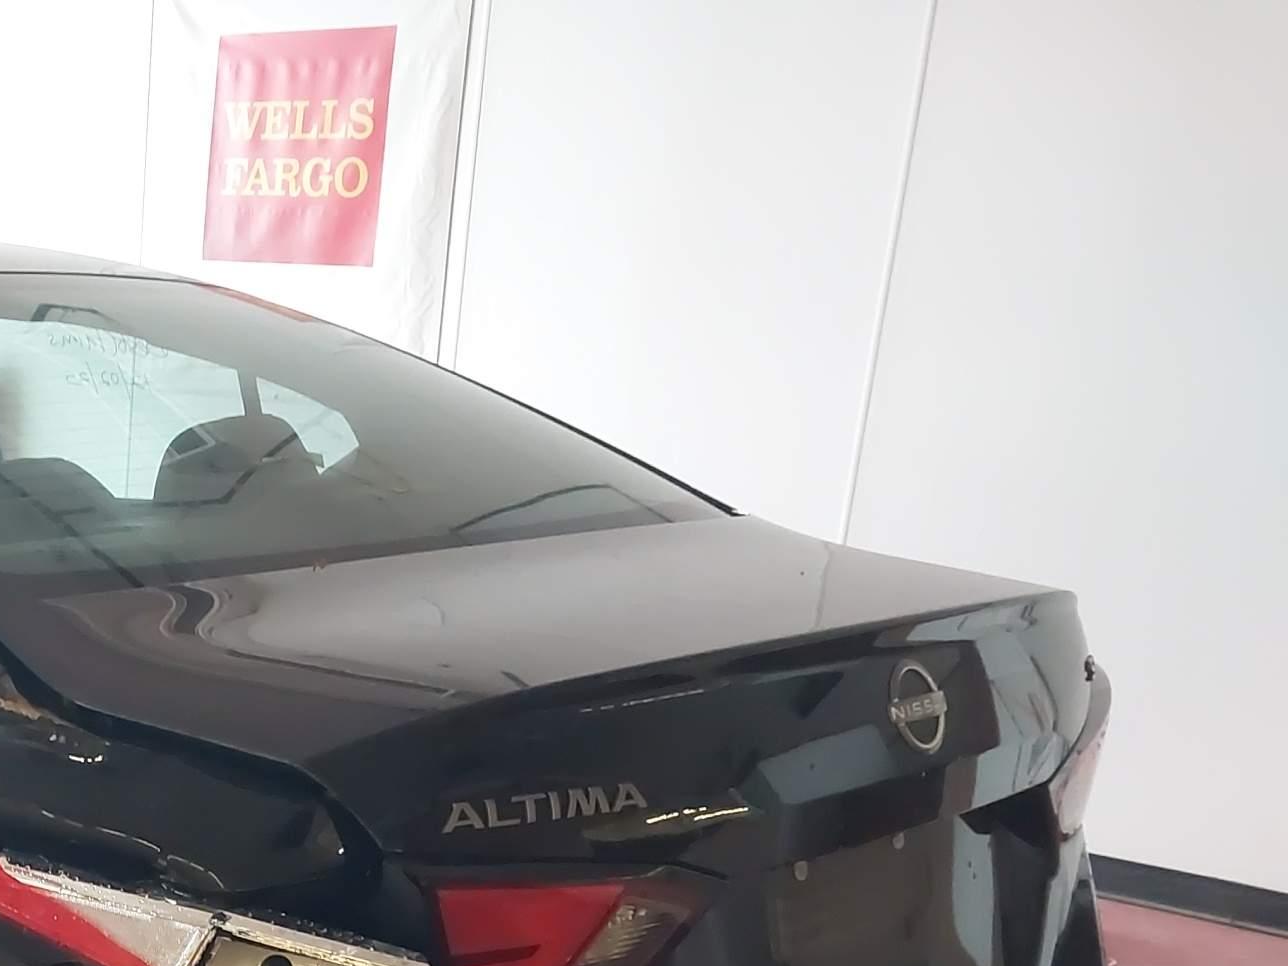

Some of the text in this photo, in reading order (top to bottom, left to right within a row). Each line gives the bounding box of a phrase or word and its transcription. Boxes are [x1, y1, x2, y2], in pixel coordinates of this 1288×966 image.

[223, 97, 375, 140] WELLS
[221, 156, 369, 198] FARGO
[441, 783, 649, 834] ALTIMA
